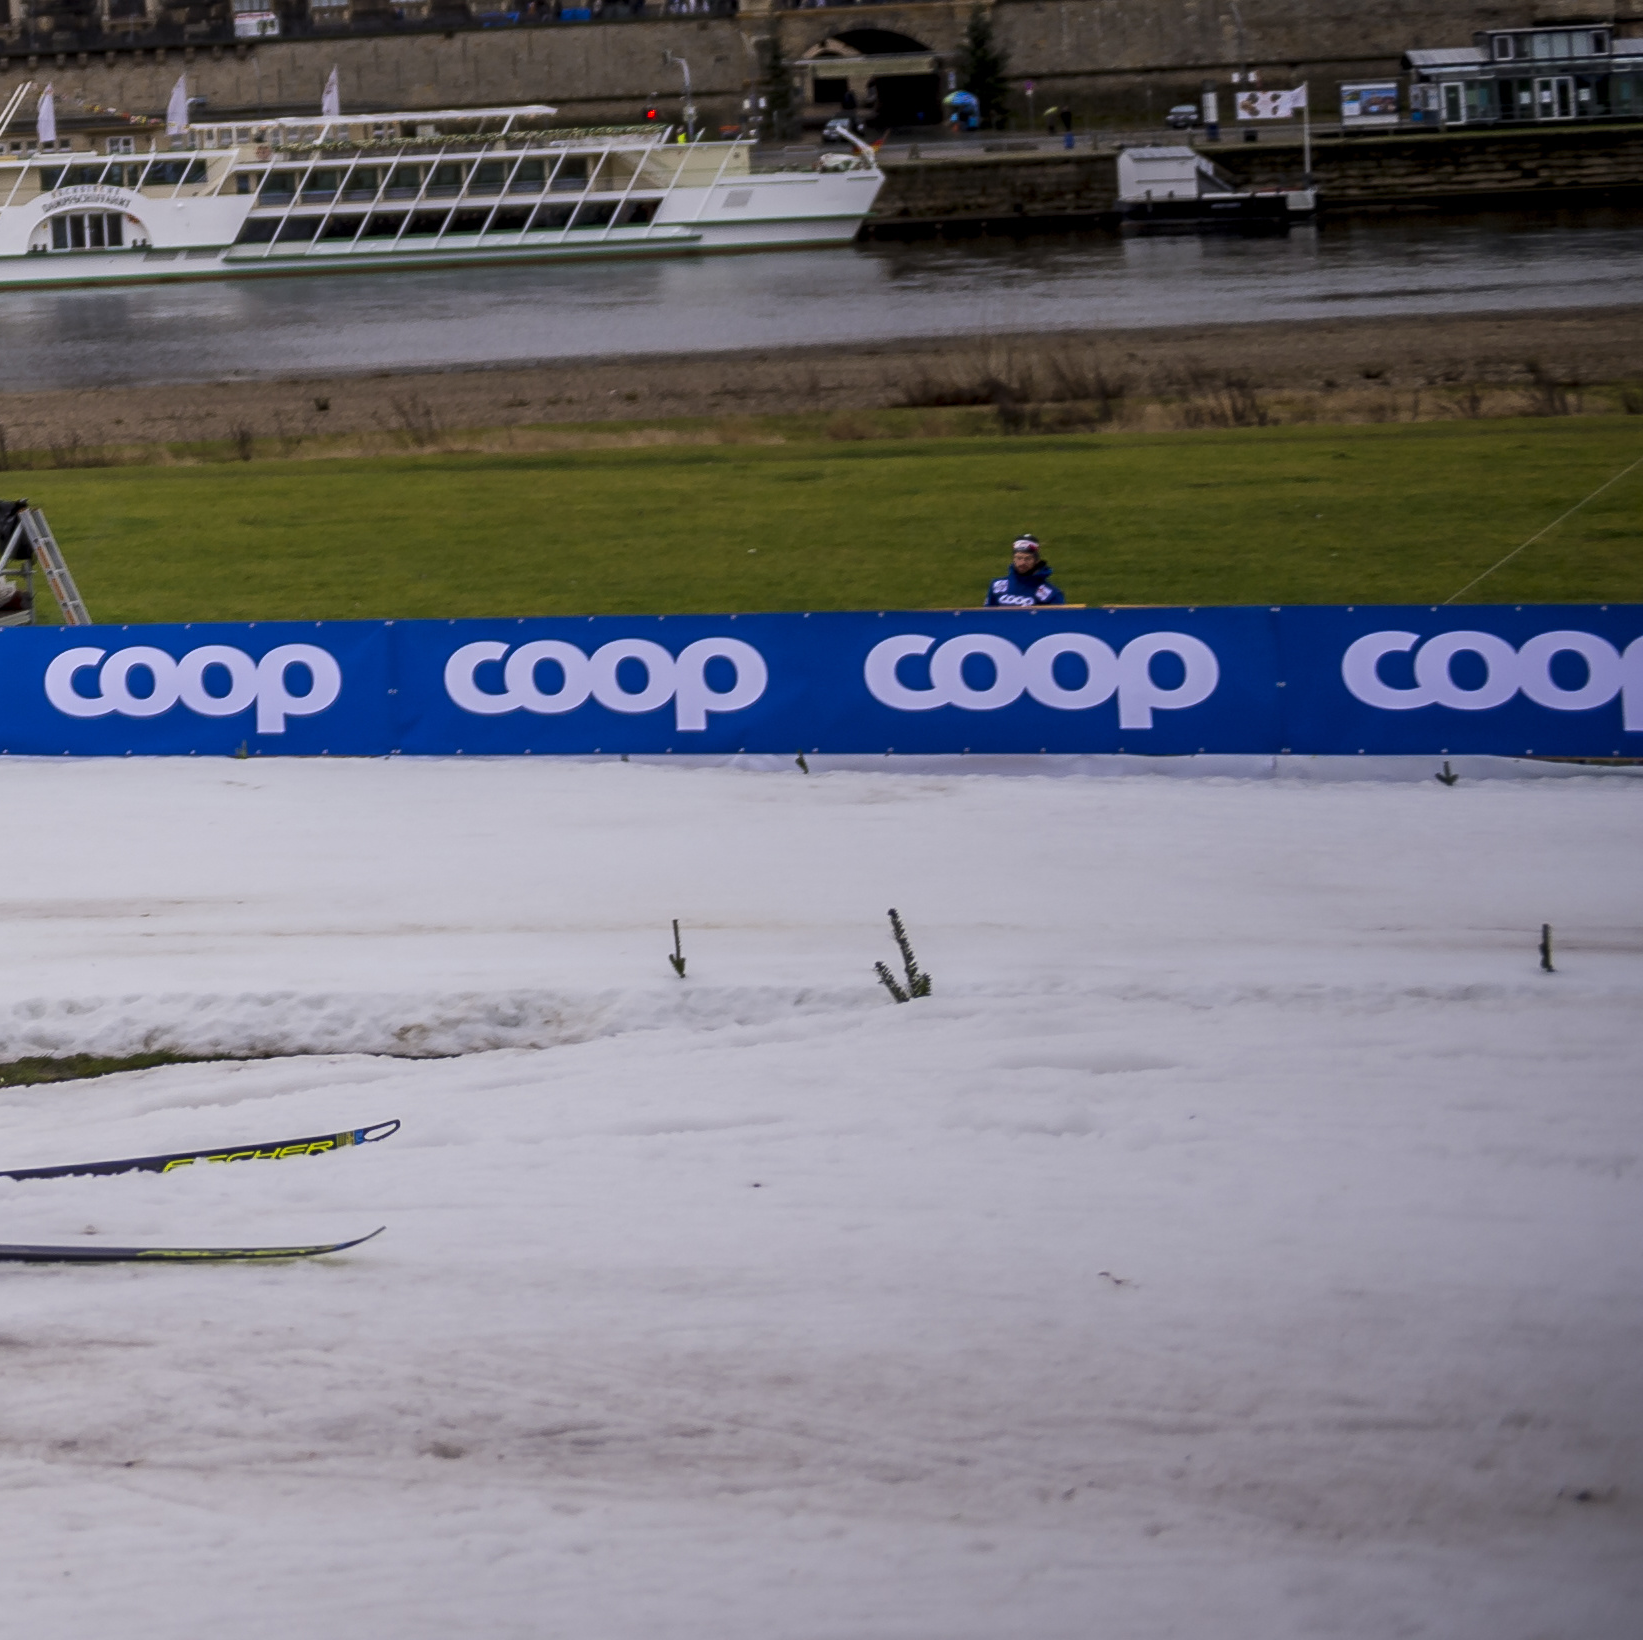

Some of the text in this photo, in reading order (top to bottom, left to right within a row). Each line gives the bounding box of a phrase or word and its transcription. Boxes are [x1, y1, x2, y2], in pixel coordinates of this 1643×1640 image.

[44, 643, 341, 734] coop
[444, 637, 768, 731] coop
[864, 631, 1219, 729] coop
[1342, 630, 1643, 731] coo
